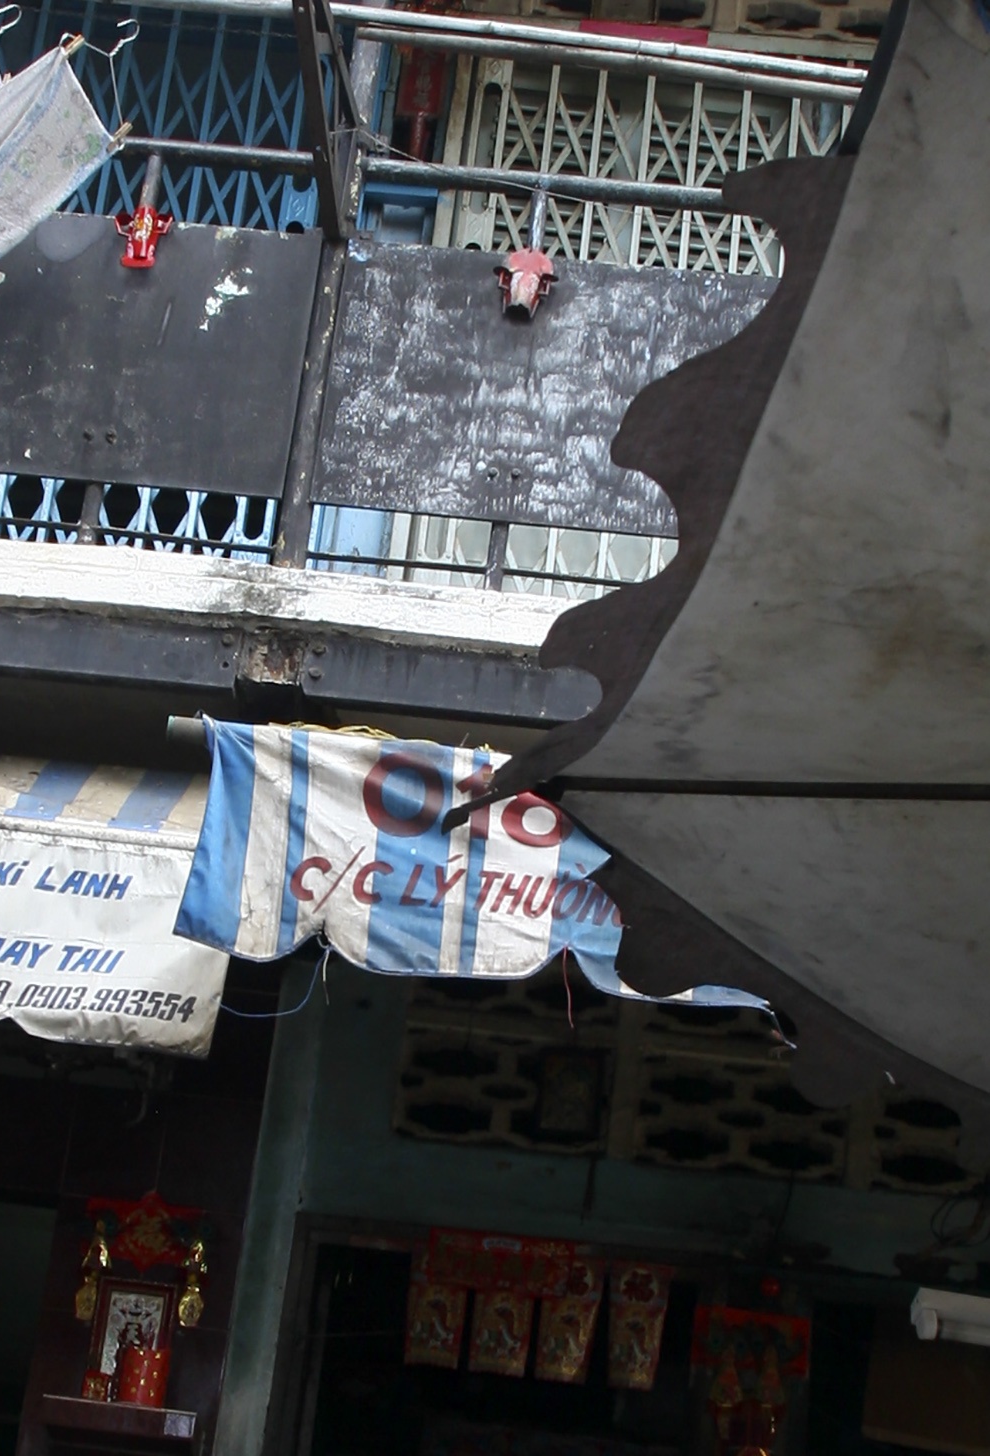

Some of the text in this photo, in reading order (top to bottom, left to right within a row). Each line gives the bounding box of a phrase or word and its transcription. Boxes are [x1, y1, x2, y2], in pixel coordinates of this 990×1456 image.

[34, 866, 133, 900] LANH
[290, 845, 626, 928] C/C LÝ THƯỜN
